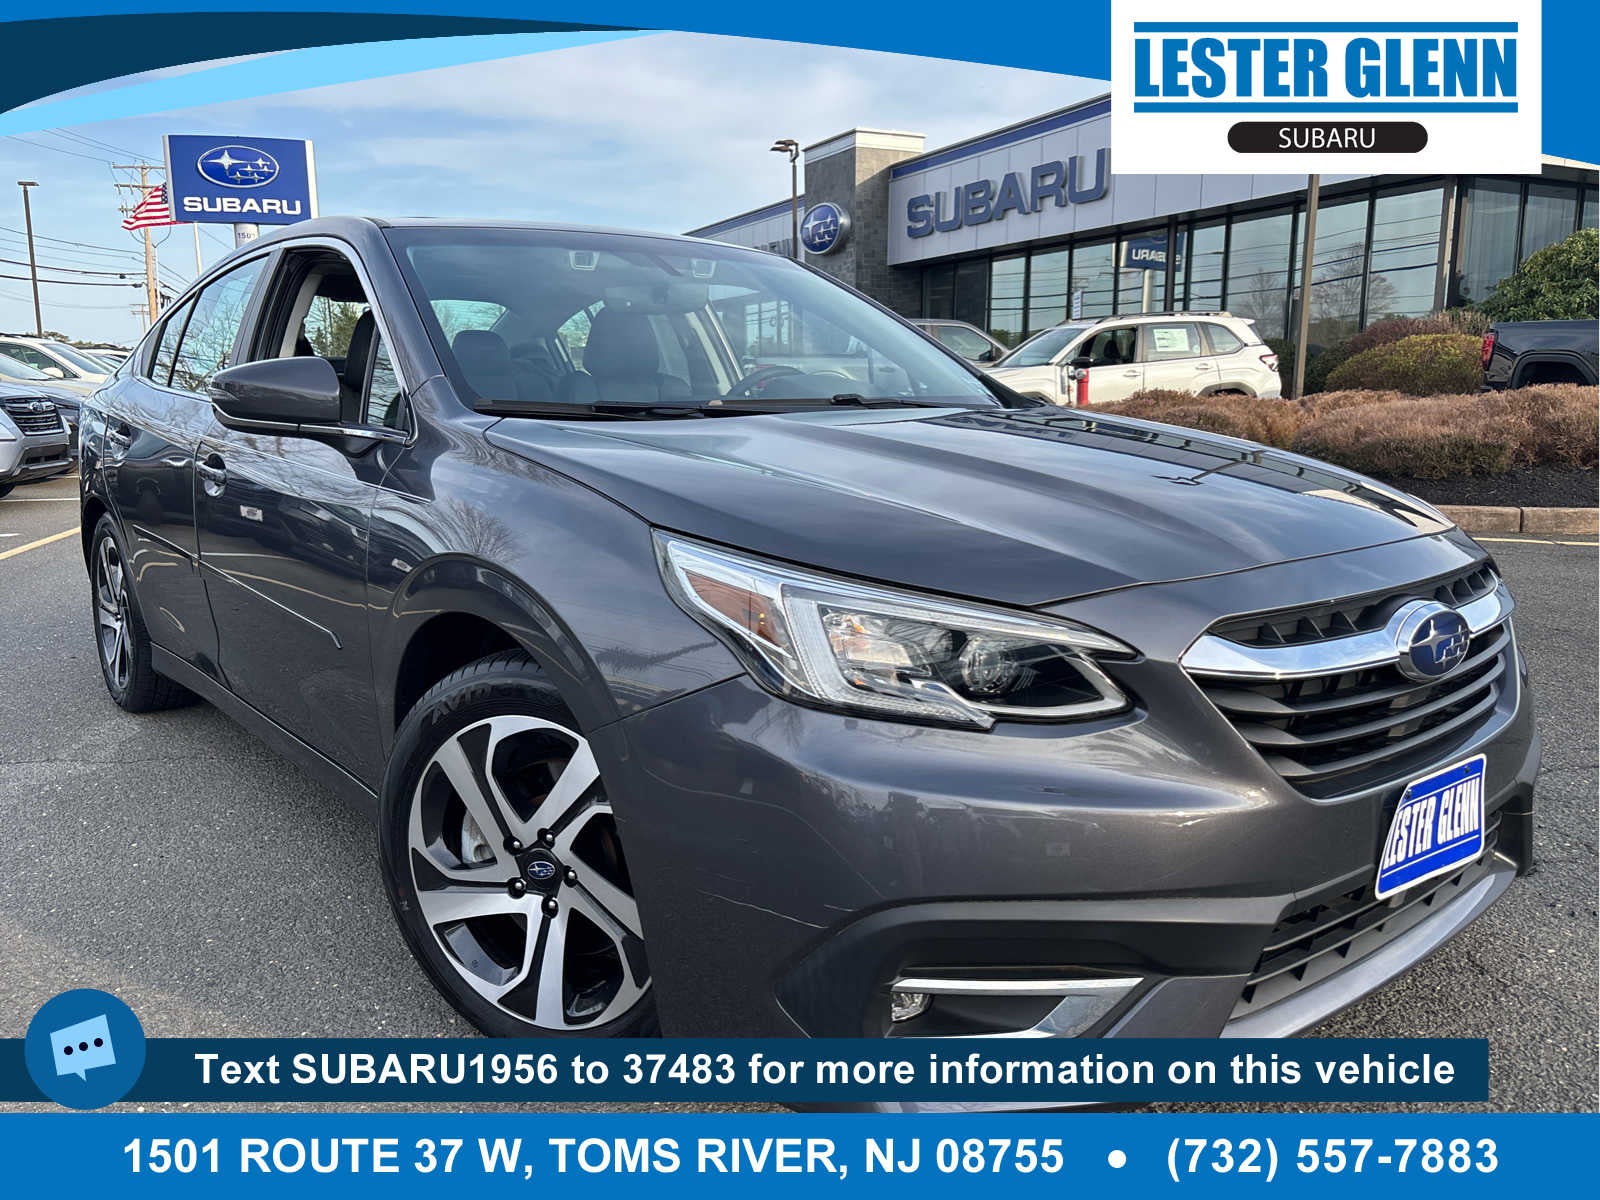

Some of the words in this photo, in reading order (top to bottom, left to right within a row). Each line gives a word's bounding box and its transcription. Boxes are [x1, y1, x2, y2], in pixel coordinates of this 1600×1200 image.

[183, 196, 301, 215] SUBARU
[907, 149, 1107, 239] SUBARU
[1382, 796, 1437, 871] LESTER
[1437, 776, 1480, 845] GLENN
